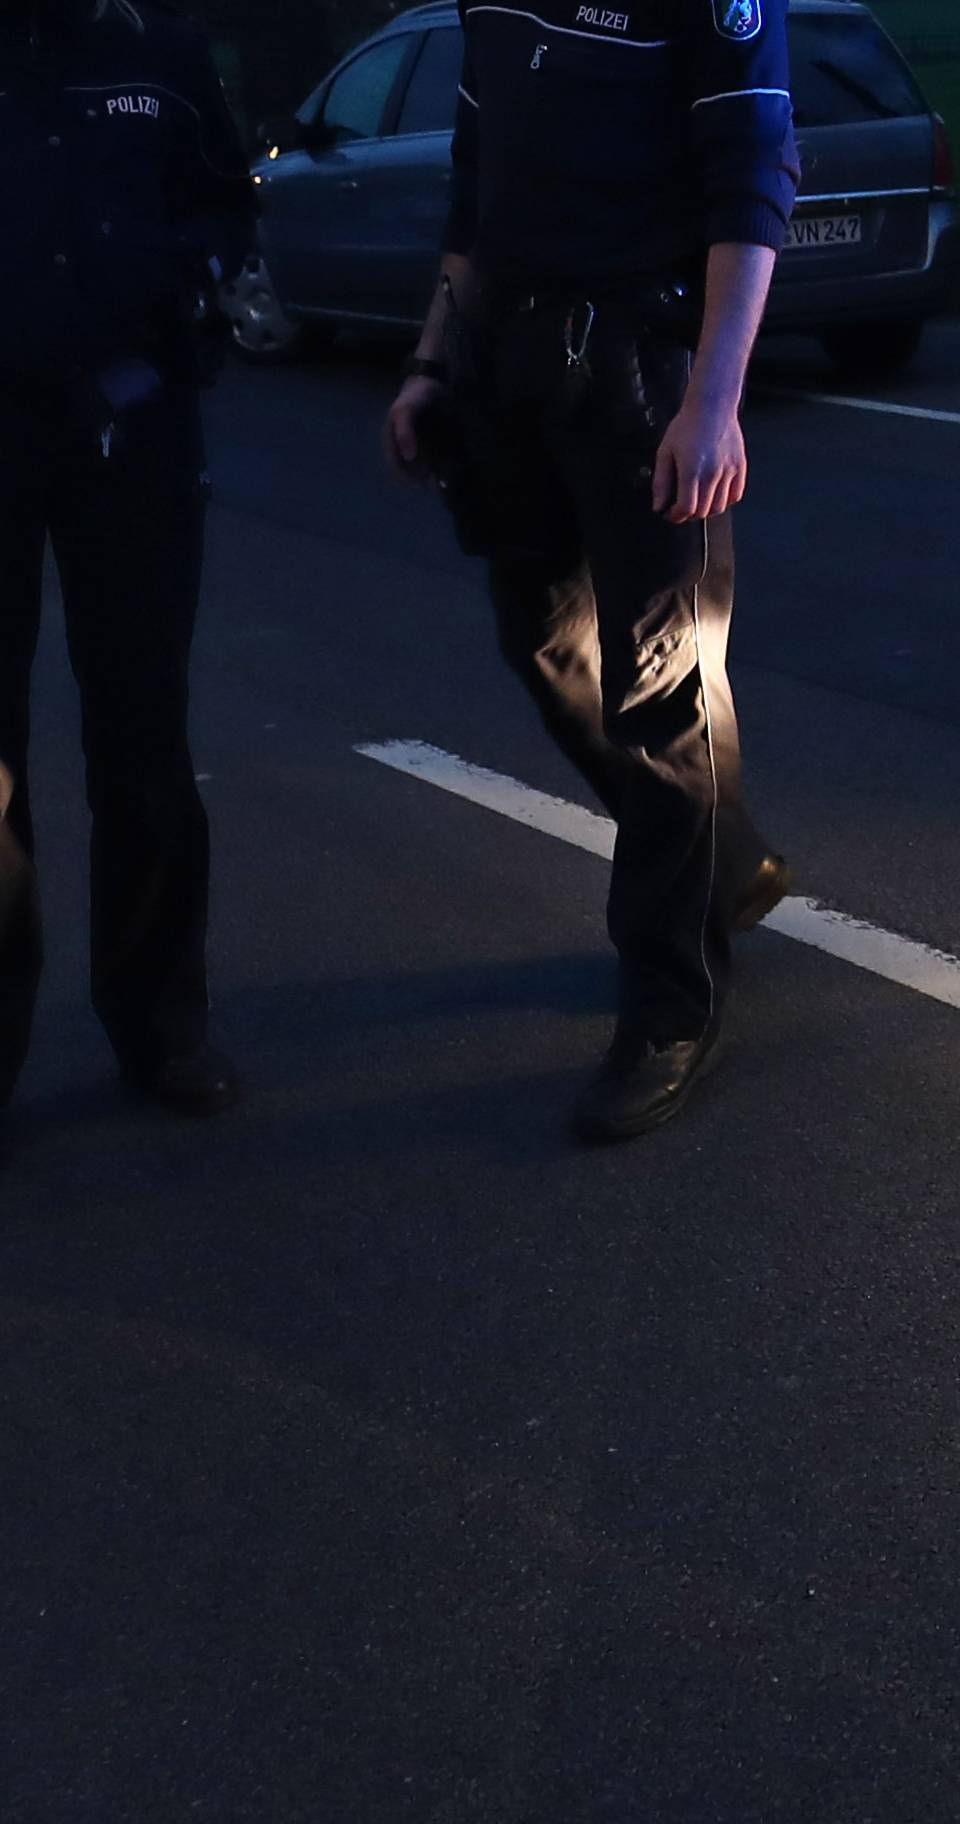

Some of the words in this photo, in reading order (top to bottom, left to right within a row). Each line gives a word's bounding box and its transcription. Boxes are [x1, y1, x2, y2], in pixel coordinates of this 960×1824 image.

[576, 5, 629, 31] POLIZEI
[793, 221, 819, 243] VN
[824, 218, 858, 241] 247
